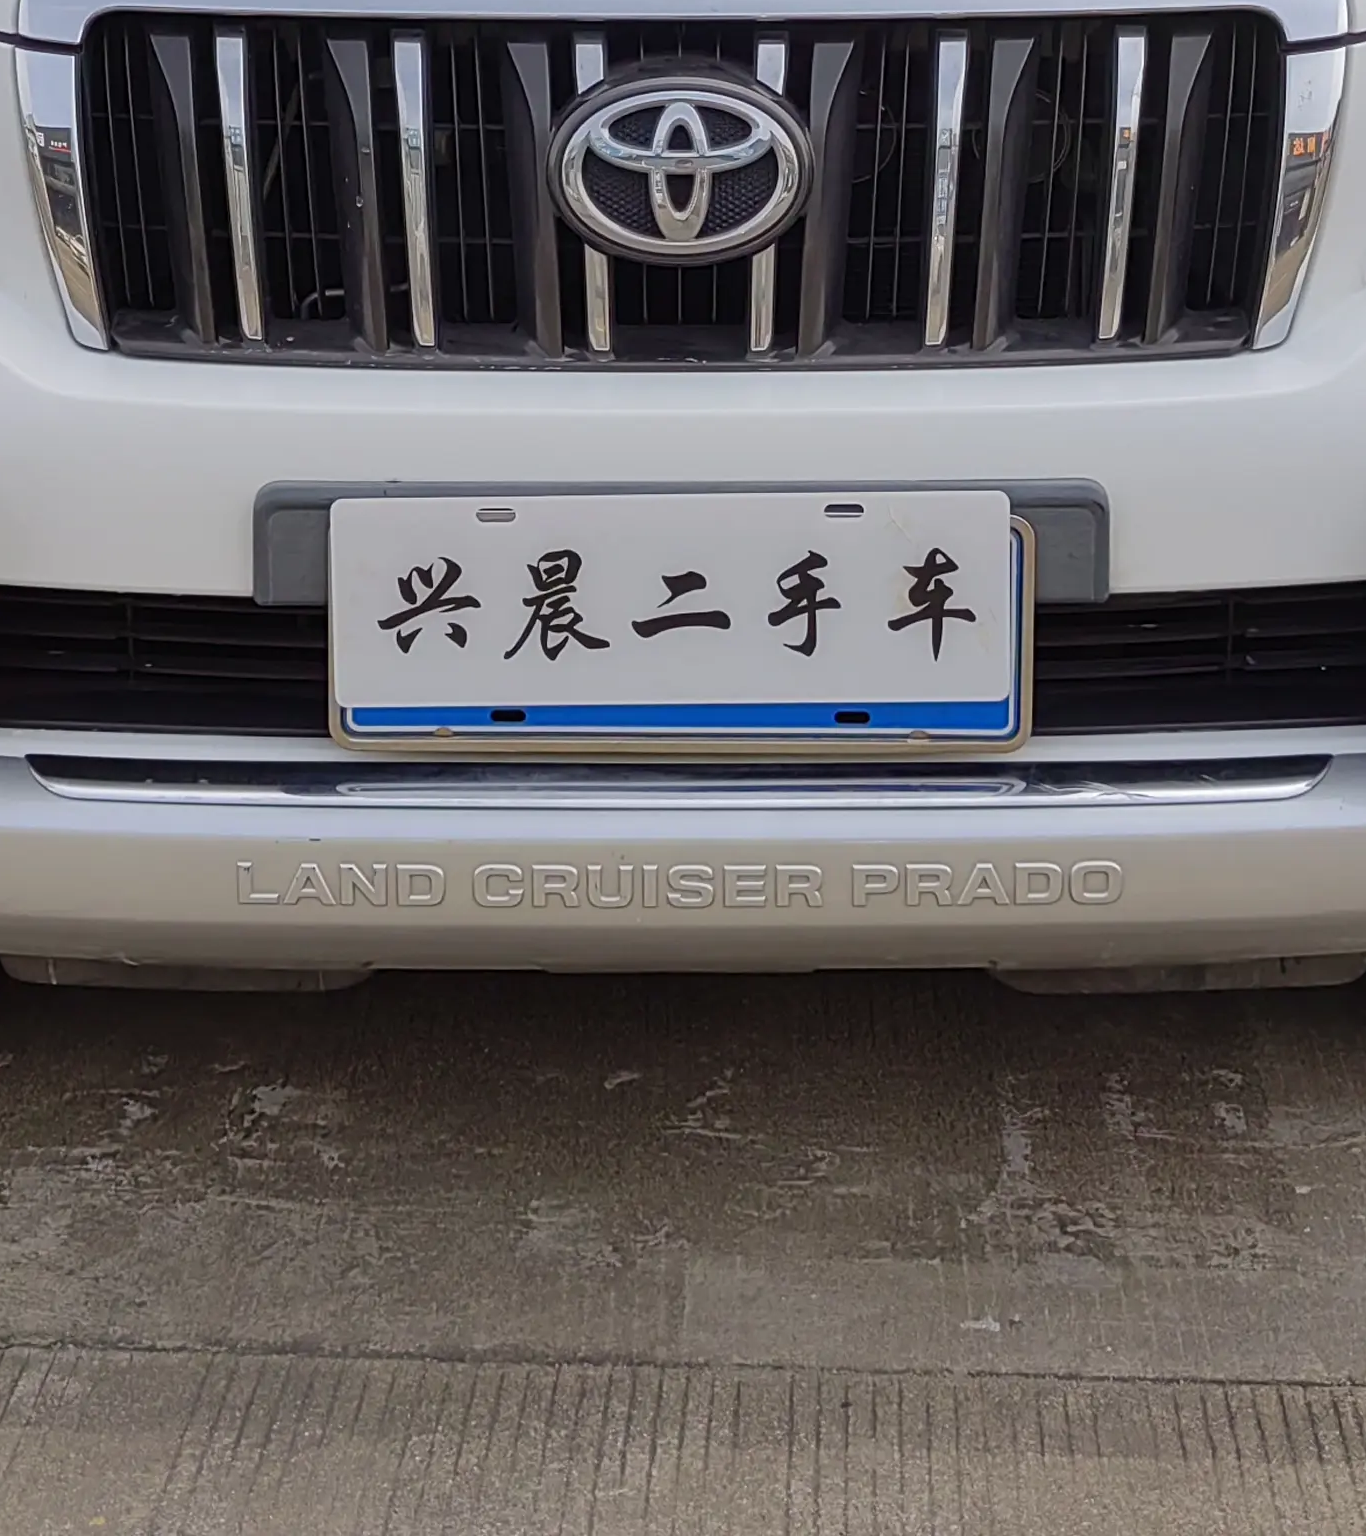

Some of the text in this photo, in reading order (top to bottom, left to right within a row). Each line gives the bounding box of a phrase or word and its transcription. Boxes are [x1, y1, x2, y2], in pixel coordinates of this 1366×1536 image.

[376, 547, 978, 662] 兴晨二手车
[236, 859, 1125, 910] LAND CRUISER PRADO
